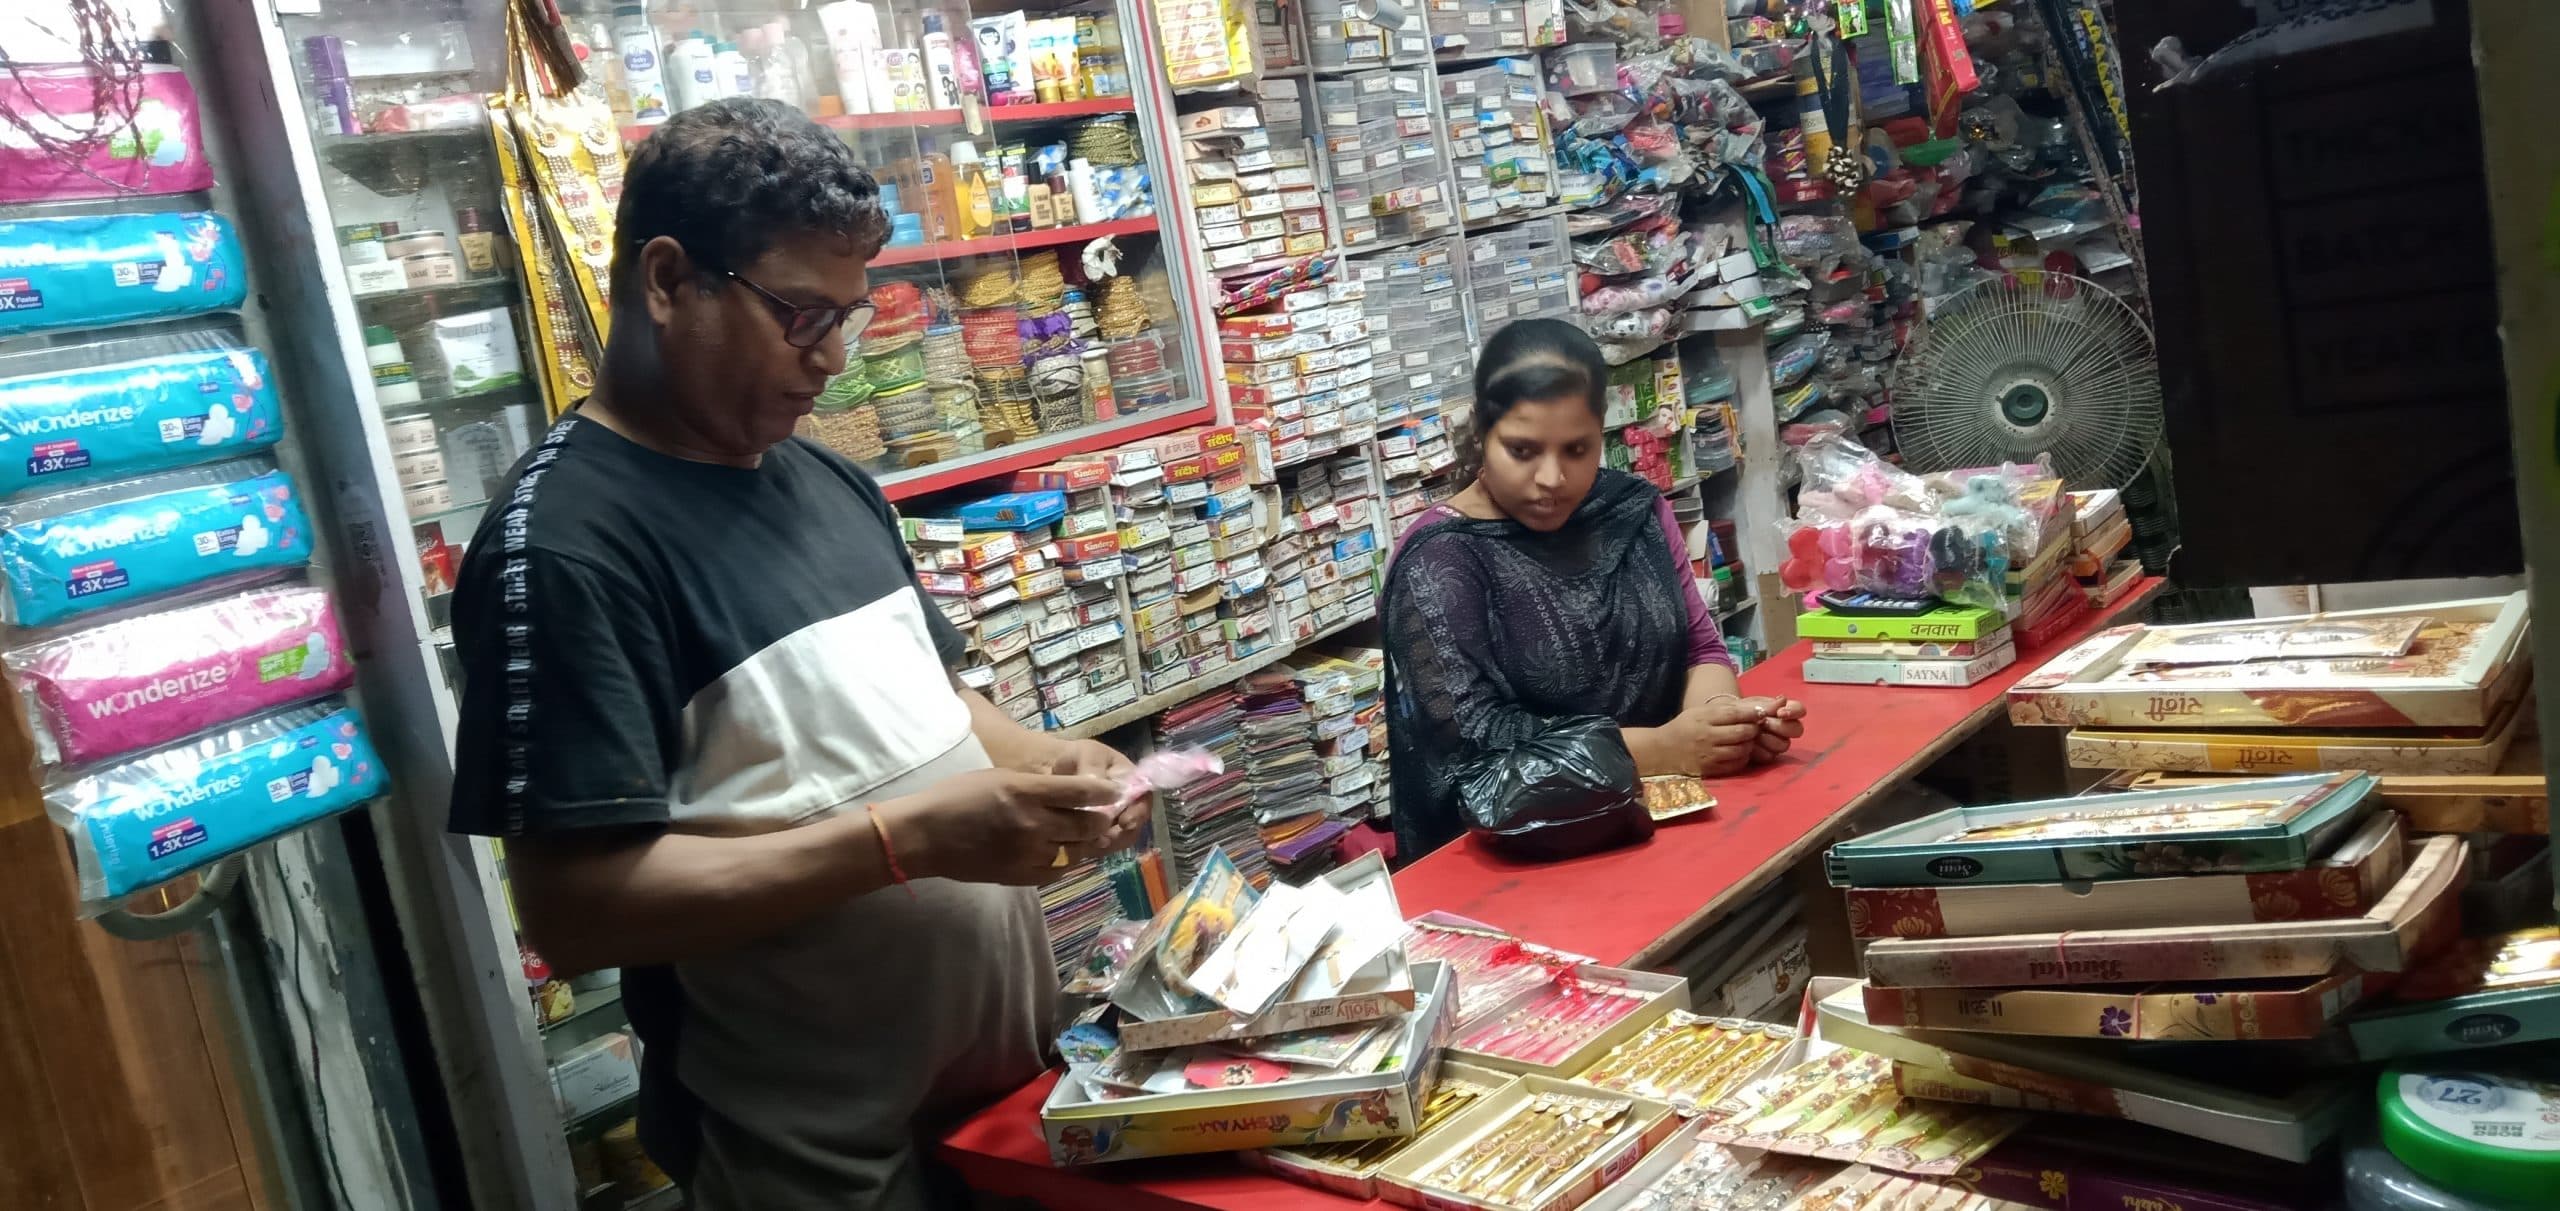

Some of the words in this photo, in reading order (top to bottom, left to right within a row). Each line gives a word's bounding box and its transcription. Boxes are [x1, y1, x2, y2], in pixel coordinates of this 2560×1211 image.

[18, 405, 134, 436] wonderize
[30, 456, 64, 474] 1.3X
[69, 578, 104, 597] 1.3X
[1909, 623, 1962, 637] वनवास
[1906, 669, 1948, 681] SAYNA
[87, 665, 228, 720] wonderize
[2144, 697, 2204, 722] रानी
[133, 774, 242, 822] wonderize
[150, 836, 184, 858] 1.3X
[1335, 1000, 1380, 1021] Molly
[2438, 1087, 2482, 1105] 27
